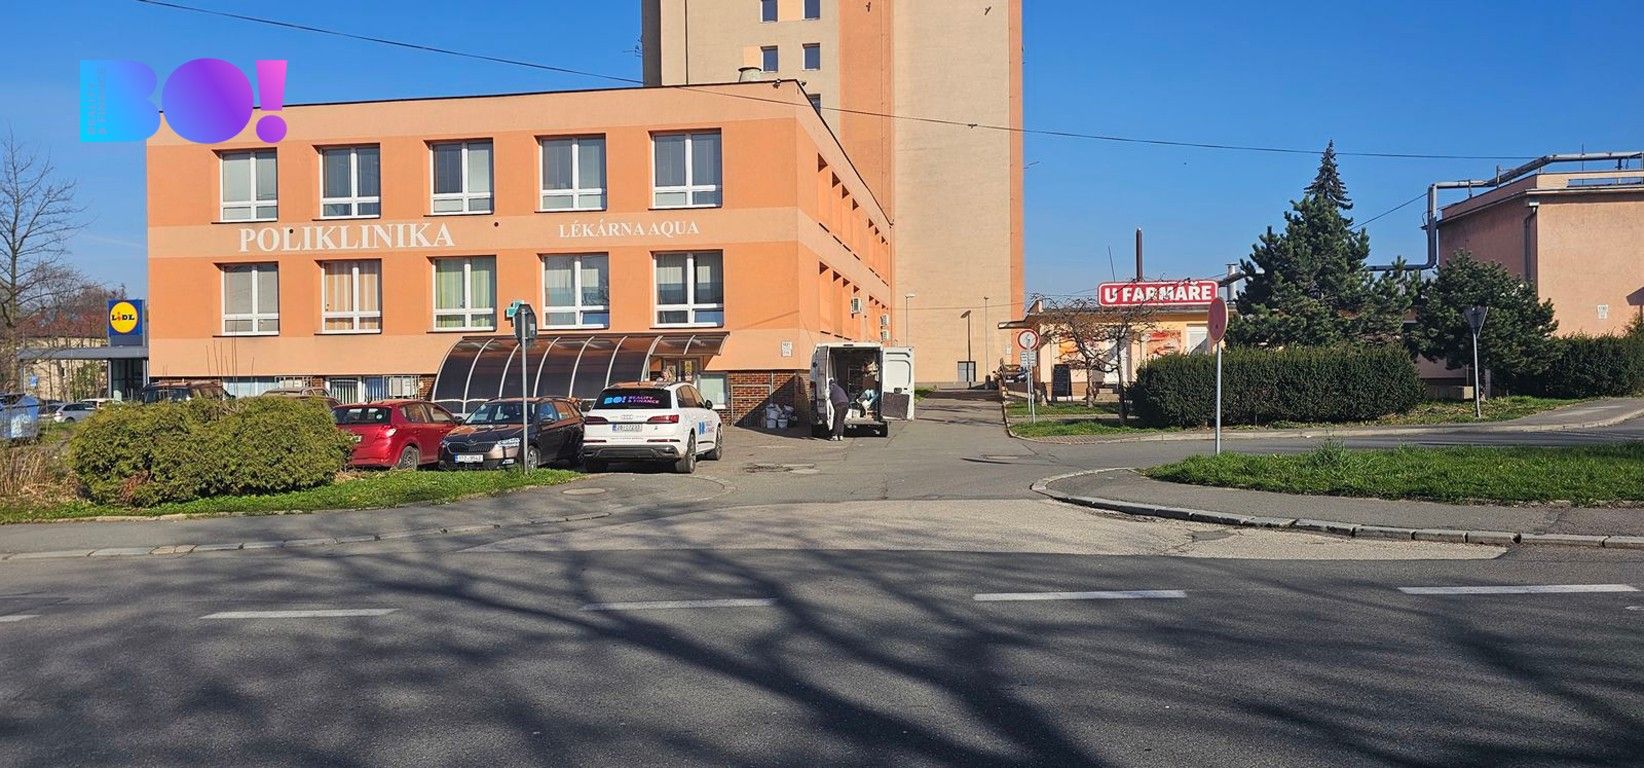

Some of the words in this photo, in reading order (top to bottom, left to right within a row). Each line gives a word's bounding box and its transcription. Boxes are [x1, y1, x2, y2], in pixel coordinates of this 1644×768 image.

[238, 222, 455, 252] POLIKLINIKA
[559, 219, 645, 238] LÉKÁRNA
[649, 220, 700, 238] AQUA
[1104, 287, 1118, 303] U
[1122, 281, 1212, 303] FARMÁŘE
[604, 395, 626, 405] BO!
